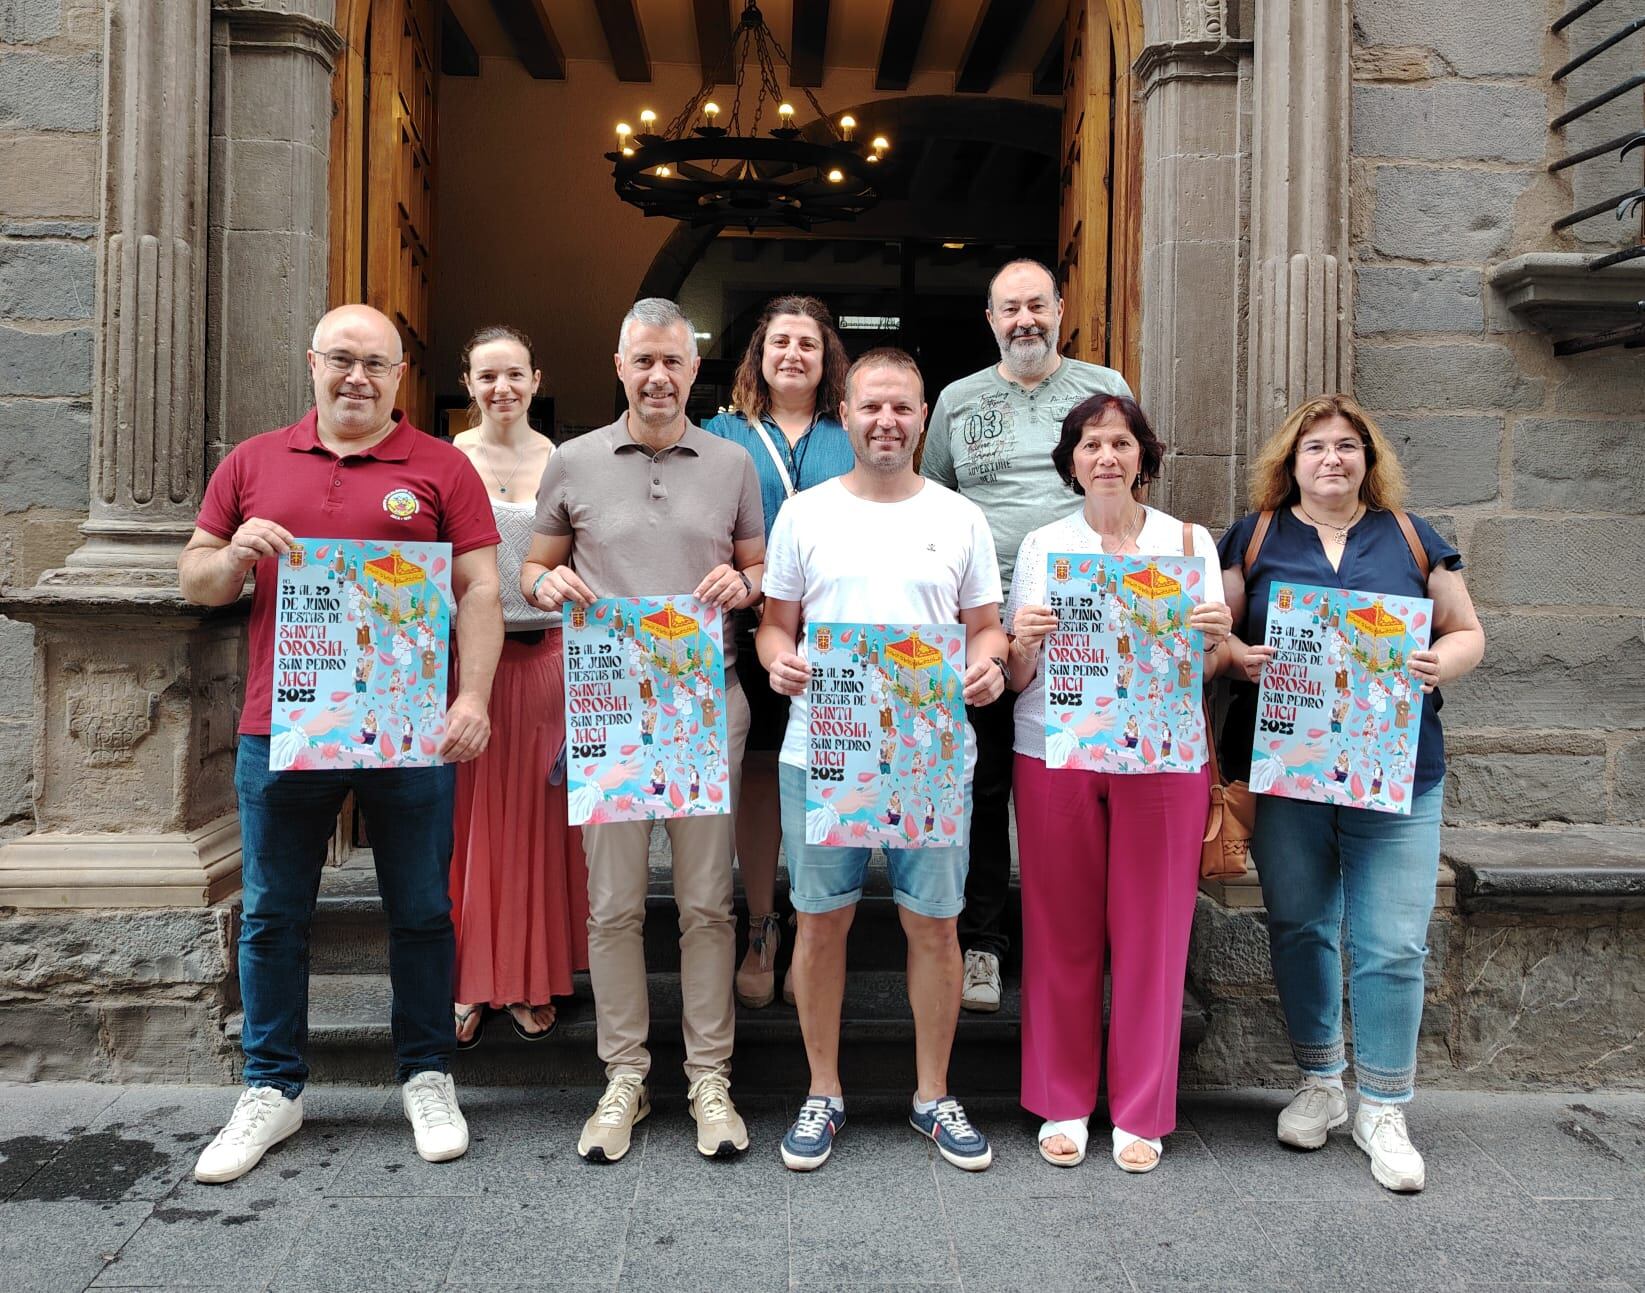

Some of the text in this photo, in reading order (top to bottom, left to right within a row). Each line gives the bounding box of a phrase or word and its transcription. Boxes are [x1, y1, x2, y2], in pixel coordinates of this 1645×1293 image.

[964, 410, 1002, 444] 03
[282, 584, 330, 595] 23 AL 29
[282, 597, 340, 611] DE JUNIO
[1051, 597, 1093, 607] 23 AL 29
[280, 612, 342, 623] FIESTAS DE
[1069, 608, 1102, 621] JUNIO
[279, 625, 326, 639] SANTA
[1092, 622, 1104, 633] DE
[1270, 626, 1313, 638] 23 AL 29
[1049, 634, 1089, 646] SANTA
[1270, 636, 1322, 653] DE JUNIO
[278, 640, 342, 656] OROSIA
[568, 644, 611, 655] 23 AL 29
[569, 656, 621, 670] DE JUNIO
[1049, 648, 1104, 664] OROSIA
[1310, 655, 1323, 666] DE
[278, 658, 346, 670] SAN PEDRO
[1049, 664, 1108, 676] SAN PEDRO
[1266, 662, 1308, 679] SANTA
[278, 672, 316, 687] JACA
[569, 669, 624, 682] FIESTAS DE
[812, 668, 854, 678] 23 AL 29
[569, 682, 611, 697] SANTA
[812, 680, 864, 693] DE JUNIO
[1050, 677, 1083, 692] JACA
[1264, 676, 1321, 696] OROSIA
[278, 688, 316, 702] 2025
[811, 694, 866, 706] FIESTAS DE
[1050, 693, 1082, 706] 2025
[1263, 692, 1324, 709] SAN PEDRO
[569, 696, 627, 714] OROSIA
[811, 706, 852, 720] SANTA
[1262, 704, 1297, 721] JACA
[571, 713, 632, 727] SAN PEDRO
[1260, 719, 1294, 735] 2025
[572, 727, 606, 744] JACA
[810, 721, 867, 738] OROSIA
[572, 744, 606, 759] 2025
[811, 738, 871, 751] SAN PEDRO
[811, 751, 845, 766] JACA
[811, 767, 844, 781] 2025
